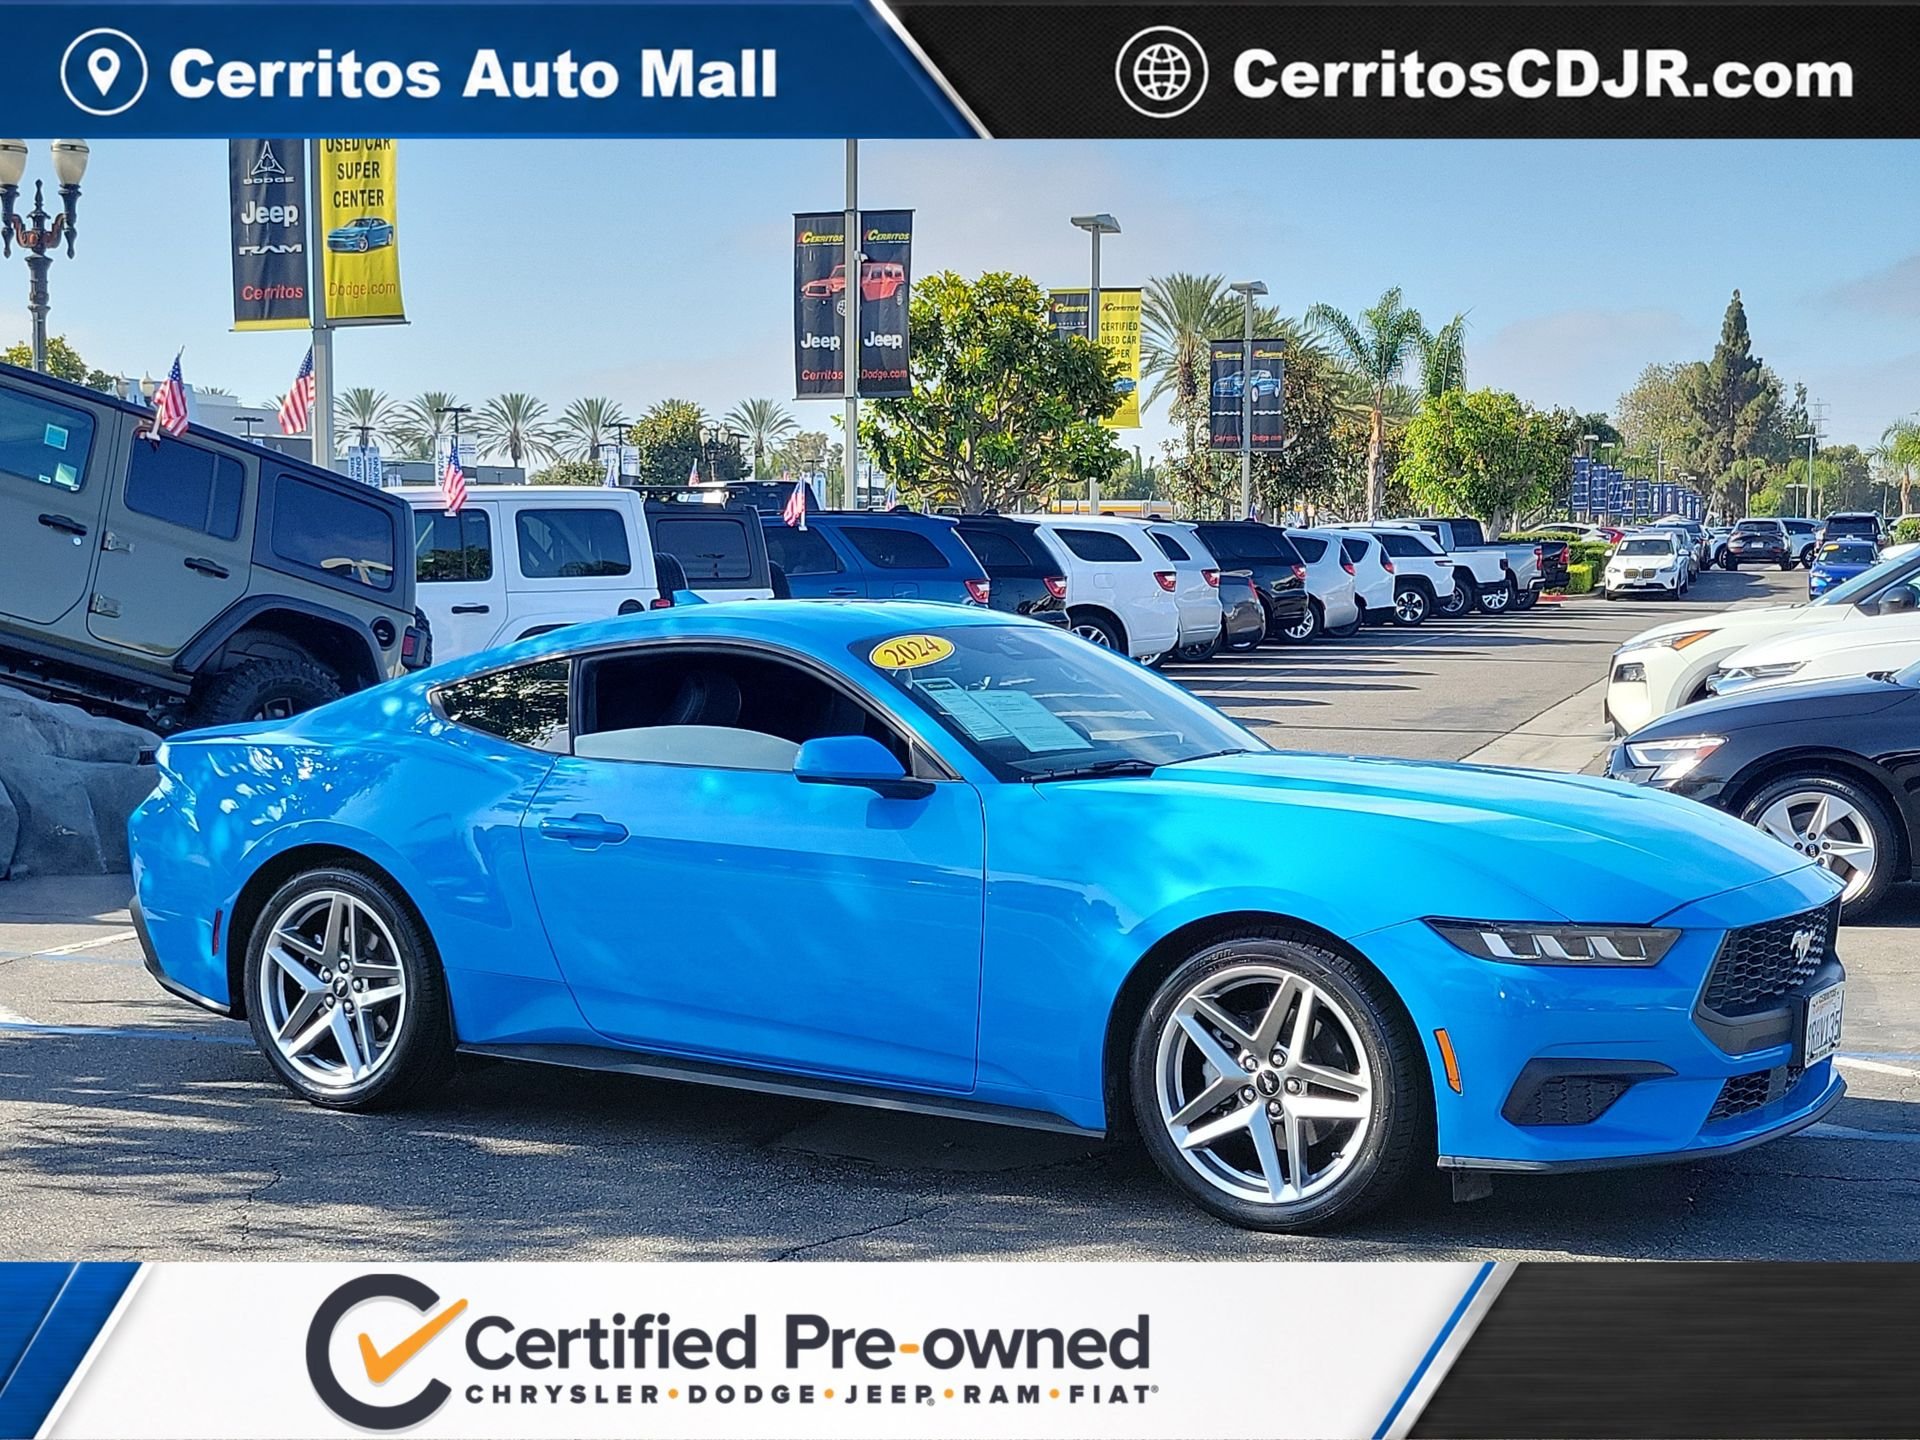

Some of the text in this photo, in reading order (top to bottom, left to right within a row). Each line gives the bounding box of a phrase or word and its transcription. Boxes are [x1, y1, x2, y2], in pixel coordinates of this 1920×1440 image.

[326, 138, 391, 153] USED CAR
[337, 161, 380, 180] SUPER
[243, 176, 295, 185] DODGE
[333, 189, 384, 208] CENTER
[241, 201, 298, 227] Jeep
[239, 243, 302, 255] RAM
[242, 284, 304, 300] Cerritos
[329, 282, 396, 298] Dodge.com
[1101, 322, 1138, 331] CERTIFIED
[800, 332, 841, 350] Jeep
[864, 331, 902, 350] Jeep
[1101, 335, 1137, 345] USED CAR
[801, 369, 844, 381] Cerritos
[861, 369, 907, 383] Dodge.com
[884, 637, 941, 665] 2024
